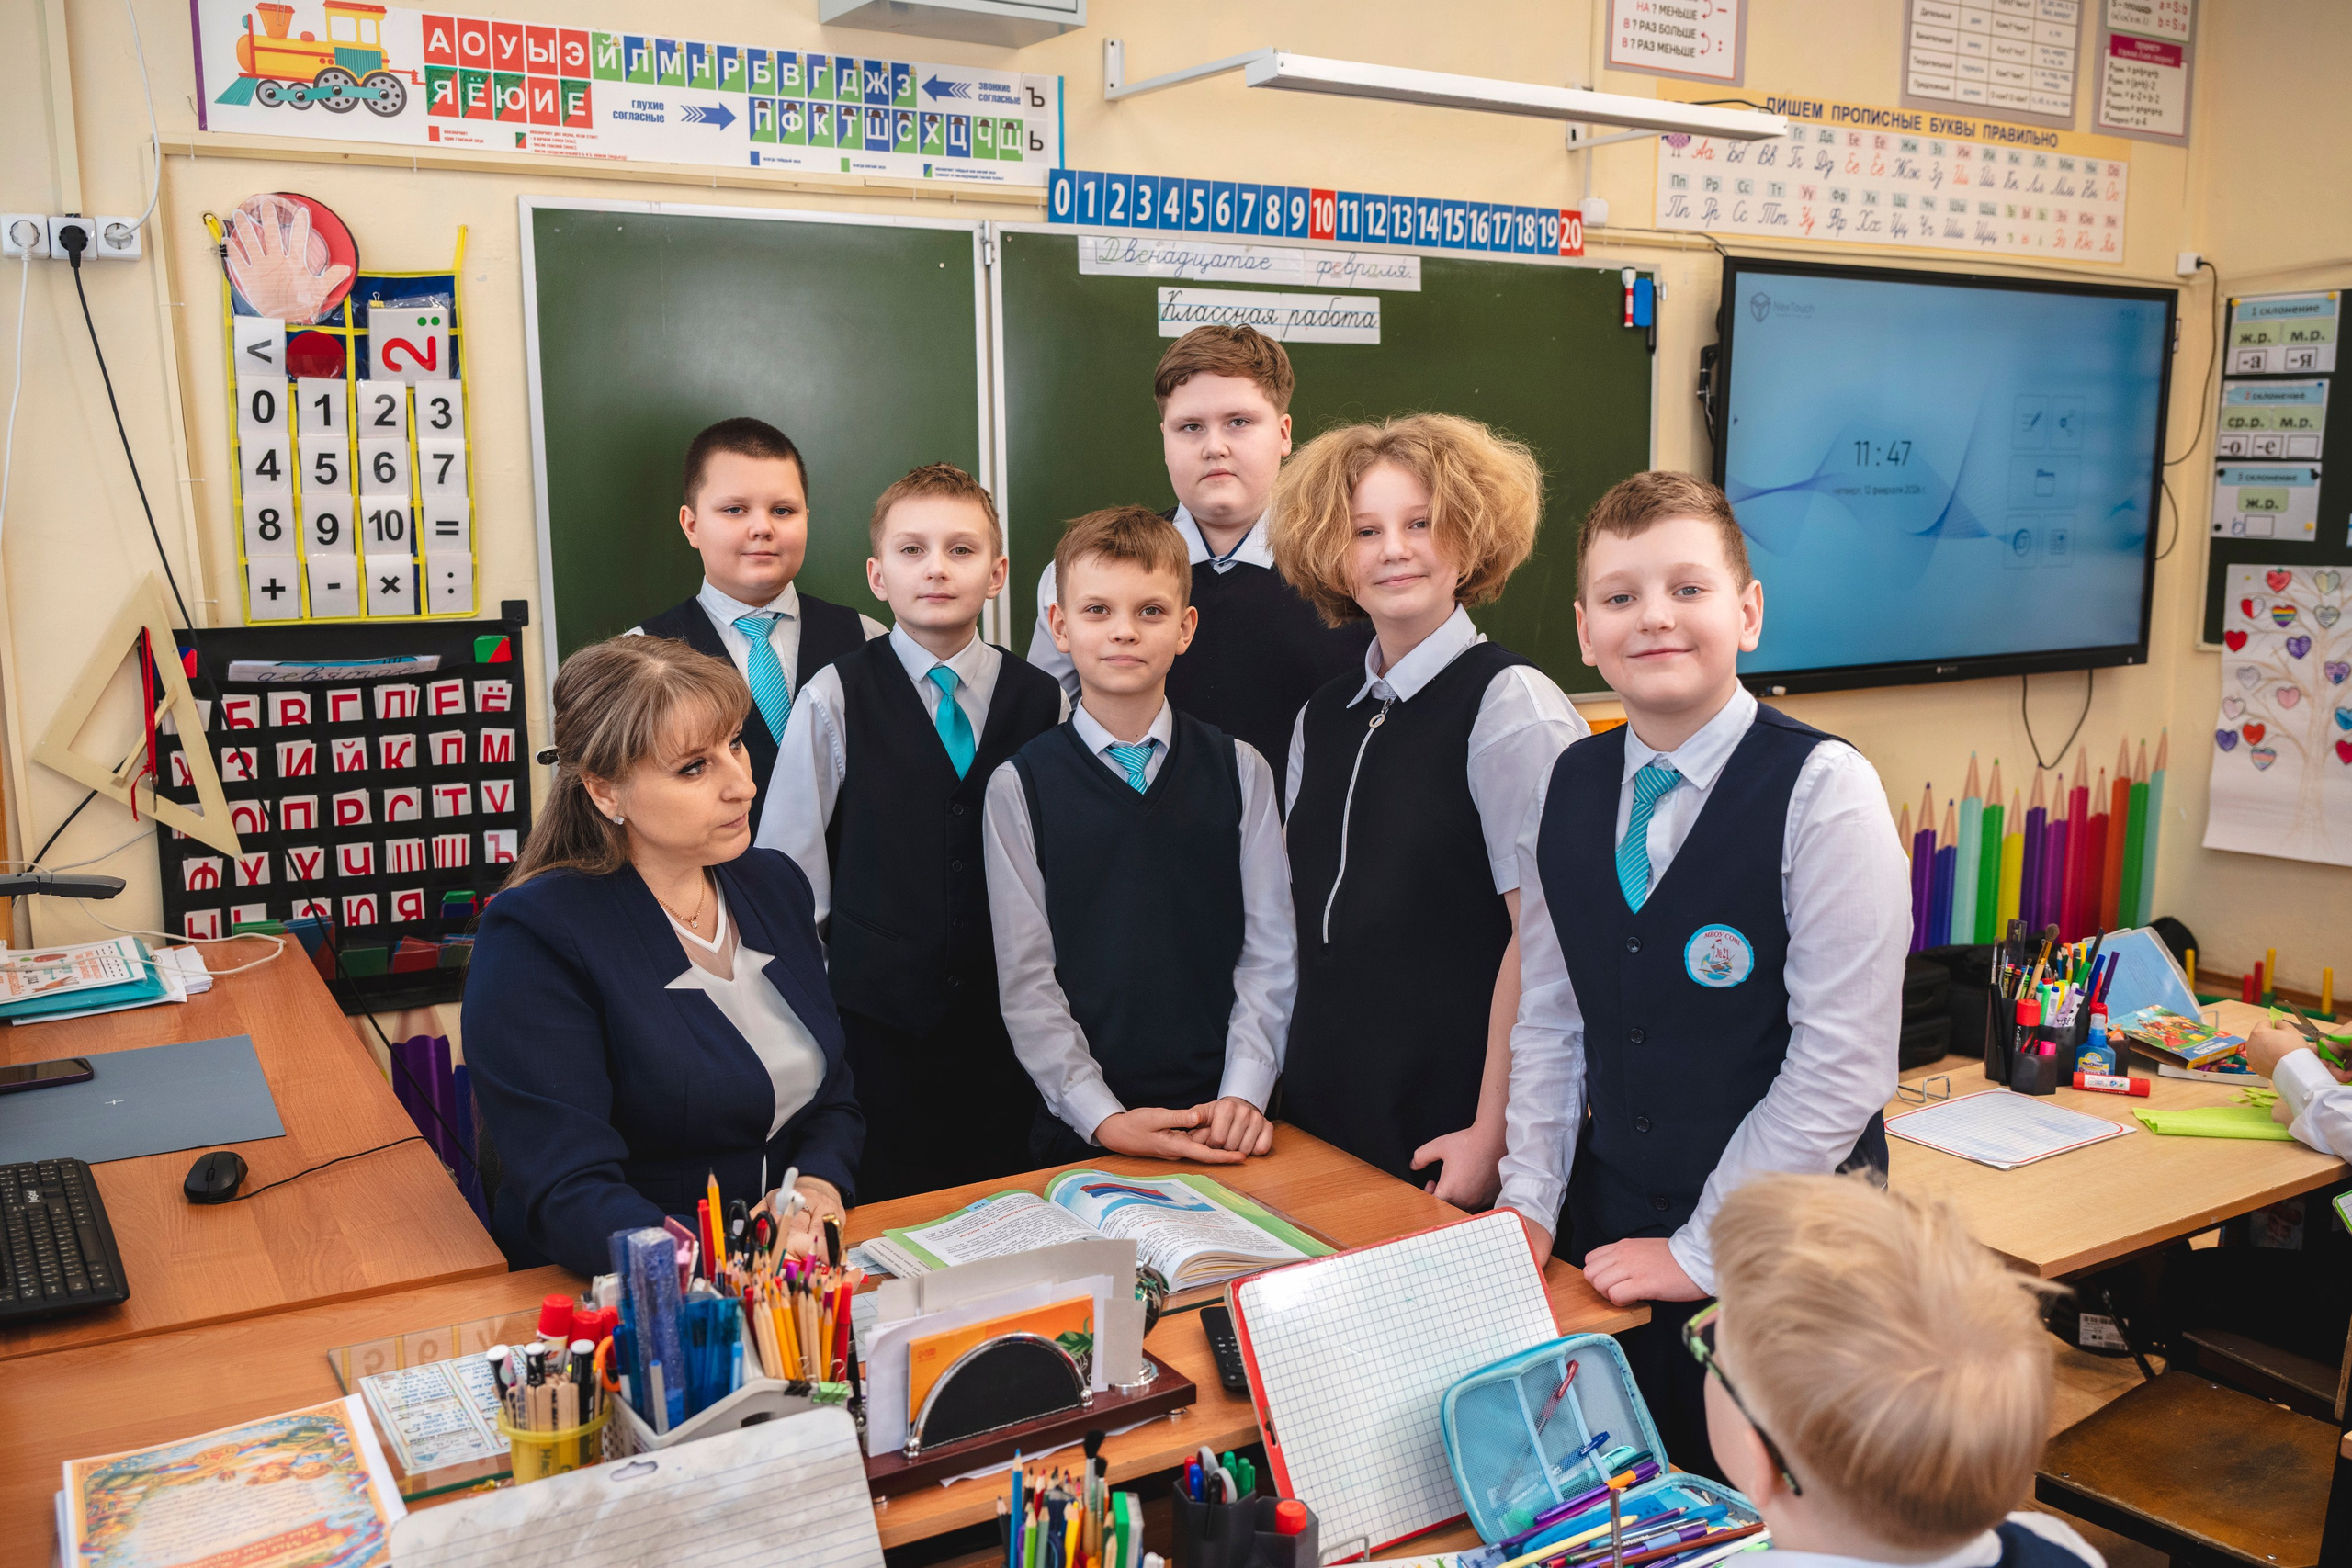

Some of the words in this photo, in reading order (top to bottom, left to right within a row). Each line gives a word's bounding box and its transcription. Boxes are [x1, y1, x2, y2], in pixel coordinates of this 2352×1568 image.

[1636, 2, 1650, 13] НА
[1659, 6, 1698, 20] МЕНЬШЕ
[1623, 18, 1630, 28] В
[1639, 20, 1657, 33] РАЗ
[1659, 25, 1697, 39] БОЛЬШЕ
[428, 28, 451, 53] А
[462, 31, 485, 56] О
[498, 34, 517, 59] У
[528, 38, 555, 63] Ы
[565, 41, 584, 66] Э
[1622, 37, 1628, 48] В
[1637, 39, 1655, 51] РАЗ
[1657, 42, 1696, 58] МЕНЬШЕ
[599, 39, 617, 69] Й
[629, 48, 648, 72] Л
[661, 51, 681, 75] М
[694, 54, 709, 78] Н
[723, 57, 740, 80] Р
[753, 59, 771, 84] Б
[783, 62, 800, 86] В
[813, 66, 828, 88] Г
[840, 69, 859, 96] Д
[865, 72, 888, 94] Ж
[897, 74, 910, 96] З
[434, 80, 453, 105] Я
[468, 77, 487, 107] Ё
[496, 85, 526, 110] Ю
[534, 88, 553, 113] И
[568, 93, 586, 116] Е
[1025, 86, 1045, 107] Ъ
[754, 107, 772, 131] П
[781, 110, 803, 133] Ф
[814, 113, 829, 136] К
[842, 116, 857, 138] Т
[866, 117, 889, 141] Ш
[897, 119, 913, 142] С
[923, 122, 940, 144] Х
[950, 123, 967, 151] Ц
[978, 125, 992, 148] Ч
[1001, 128, 1022, 154] Щ
[1767, 97, 1823, 119] ПИШЕМ
[1831, 106, 1922, 130] ПРОПИСНЫЕ
[1929, 117, 1975, 138] БУКВЫ
[1983, 124, 2059, 149] ПРАВИЛЬНО
[1030, 130, 1044, 151] Ь
[1671, 175, 1687, 188] Пп
[1055, 178, 1070, 216] 0
[1083, 181, 1096, 218] 1
[1109, 182, 1125, 220] 2
[1136, 185, 1152, 221] 3
[1163, 186, 1180, 222] 4
[1190, 188, 1204, 224] 5
[1216, 191, 1230, 226] 6
[1242, 192, 1256, 228] 7
[1265, 194, 1281, 230] 8
[1291, 196, 1306, 231] 9
[1313, 198, 1334, 232] 10
[1339, 199, 1359, 234] 11
[1365, 201, 1386, 236] 12
[1391, 204, 1412, 238] 13
[1417, 206, 1439, 240] 14
[1443, 208, 1465, 242] 15
[1469, 209, 1489, 243] 16
[1493, 210, 1511, 245] 17
[1515, 213, 1535, 247] 18
[1539, 214, 1557, 248] 19
[1561, 217, 1581, 250] 20
[1161, 290, 1278, 325] Классная
[1283, 297, 1378, 338] работа
[2261, 303, 2320, 316] склонение
[2290, 331, 2324, 345] м.р.
[252, 390, 275, 423] 0
[314, 394, 331, 426] 1
[374, 394, 397, 426] 2
[430, 397, 452, 429] 3
[255, 449, 281, 481] 4
[314, 453, 338, 484] 5
[373, 452, 397, 483] 6
[432, 454, 455, 484] 7
[258, 509, 282, 541] 8
[316, 513, 339, 545] 9
[368, 509, 404, 541] 10
[280, 699, 307, 726] В
[286, 748, 313, 777] И
